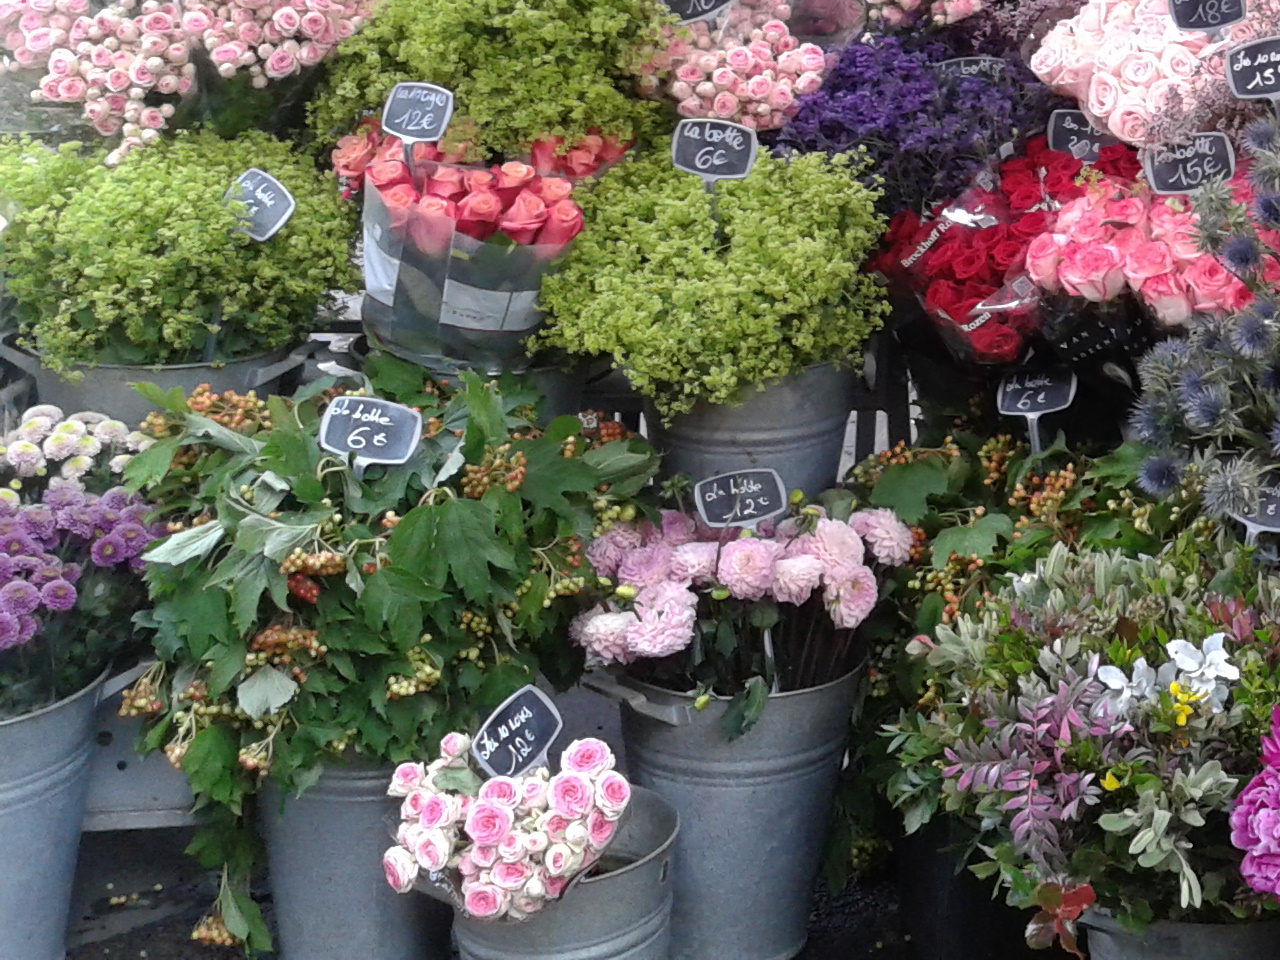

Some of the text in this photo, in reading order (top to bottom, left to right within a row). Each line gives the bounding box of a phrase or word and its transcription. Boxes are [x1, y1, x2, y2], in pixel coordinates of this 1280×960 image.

[1188, 0, 1237, 25] 18€
[394, 109, 439, 130] 12€
[704, 123, 746, 150] botte
[695, 146, 729, 169] 6€
[1168, 156, 1222, 185] 15€
[961, 311, 992, 332] Rozen
[1017, 391, 1046, 410] 6€
[352, 404, 396, 426] botte
[346, 427, 388, 449] 6€
[723, 497, 770, 519] 12€
[506, 730, 536, 775] 12€
